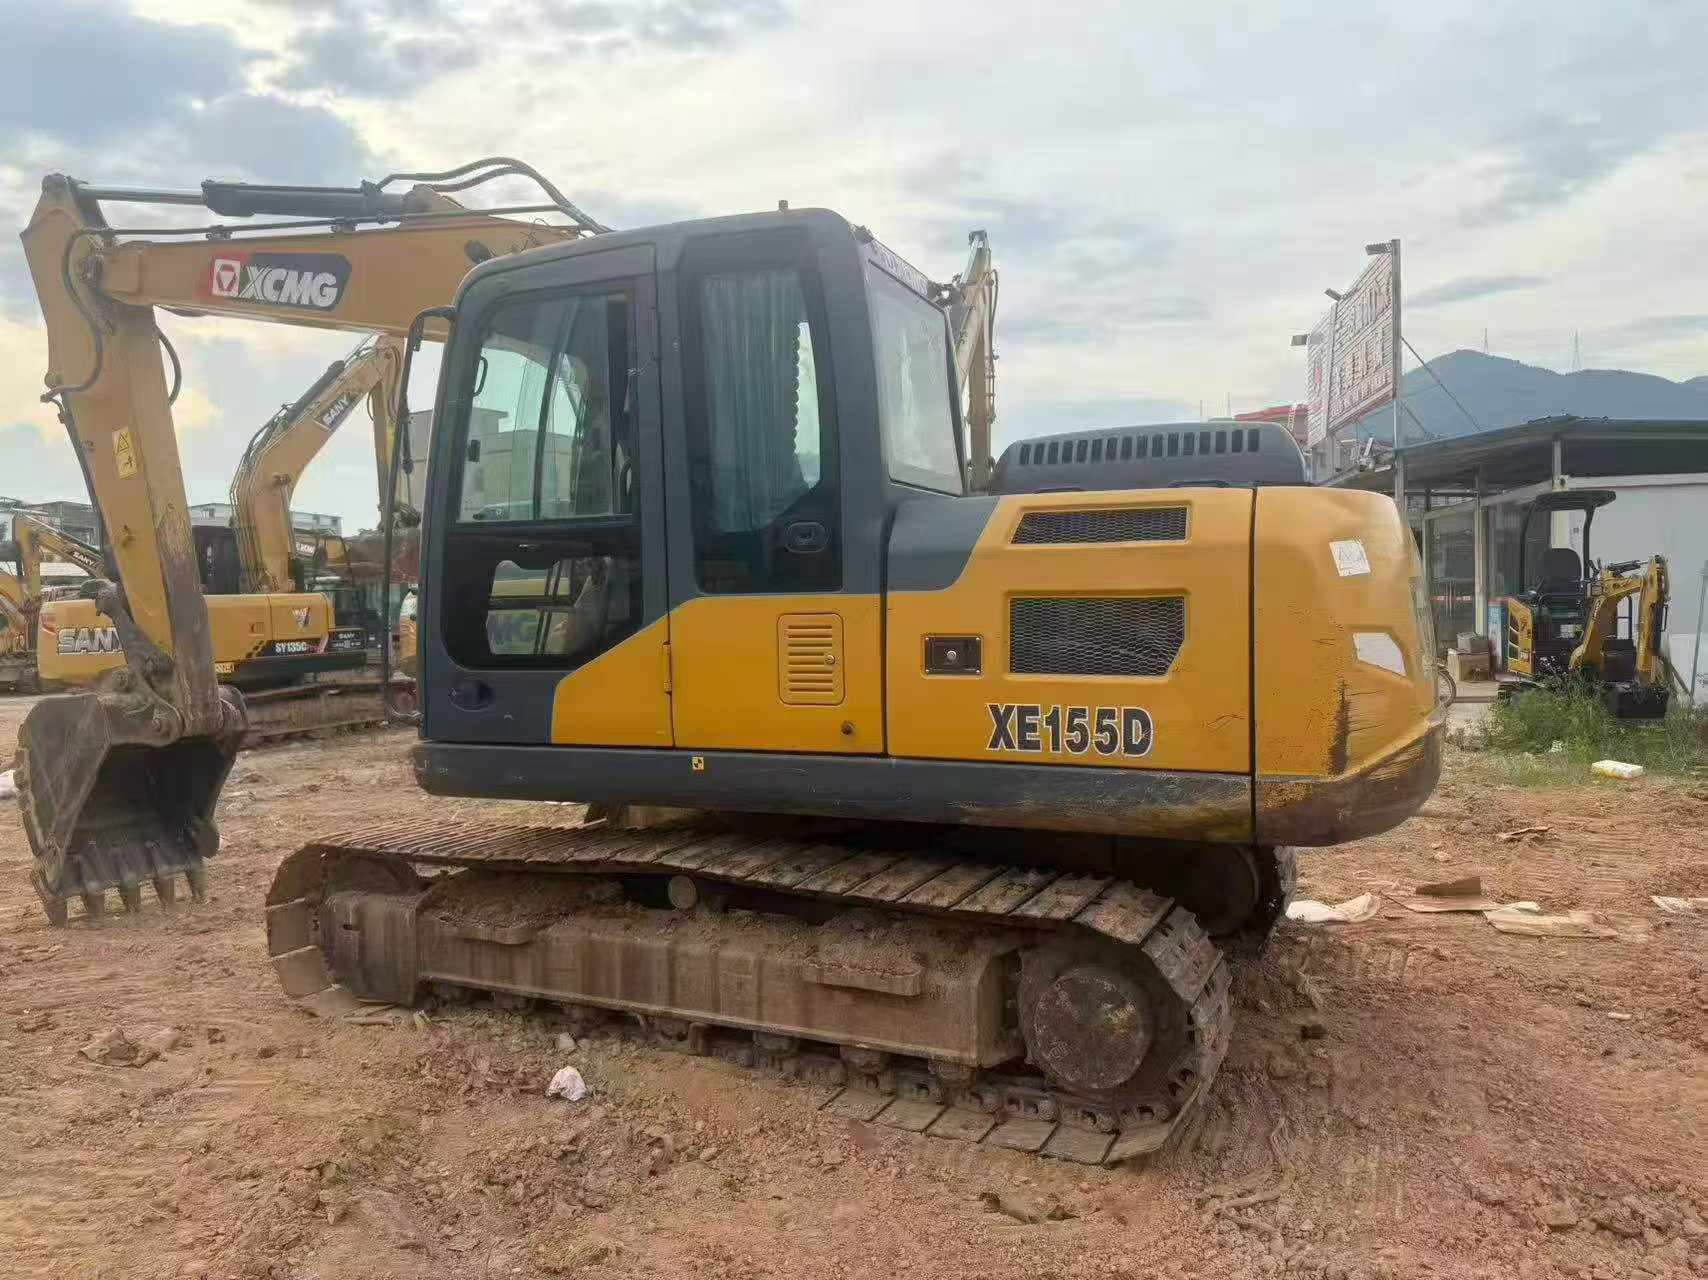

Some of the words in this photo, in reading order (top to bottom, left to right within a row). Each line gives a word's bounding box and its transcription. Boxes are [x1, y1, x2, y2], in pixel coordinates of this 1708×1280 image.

[238, 266, 338, 307] XCMG
[322, 394, 349, 424] SANY
[58, 626, 123, 655] SAN
[986, 703, 1154, 757] XE155D
